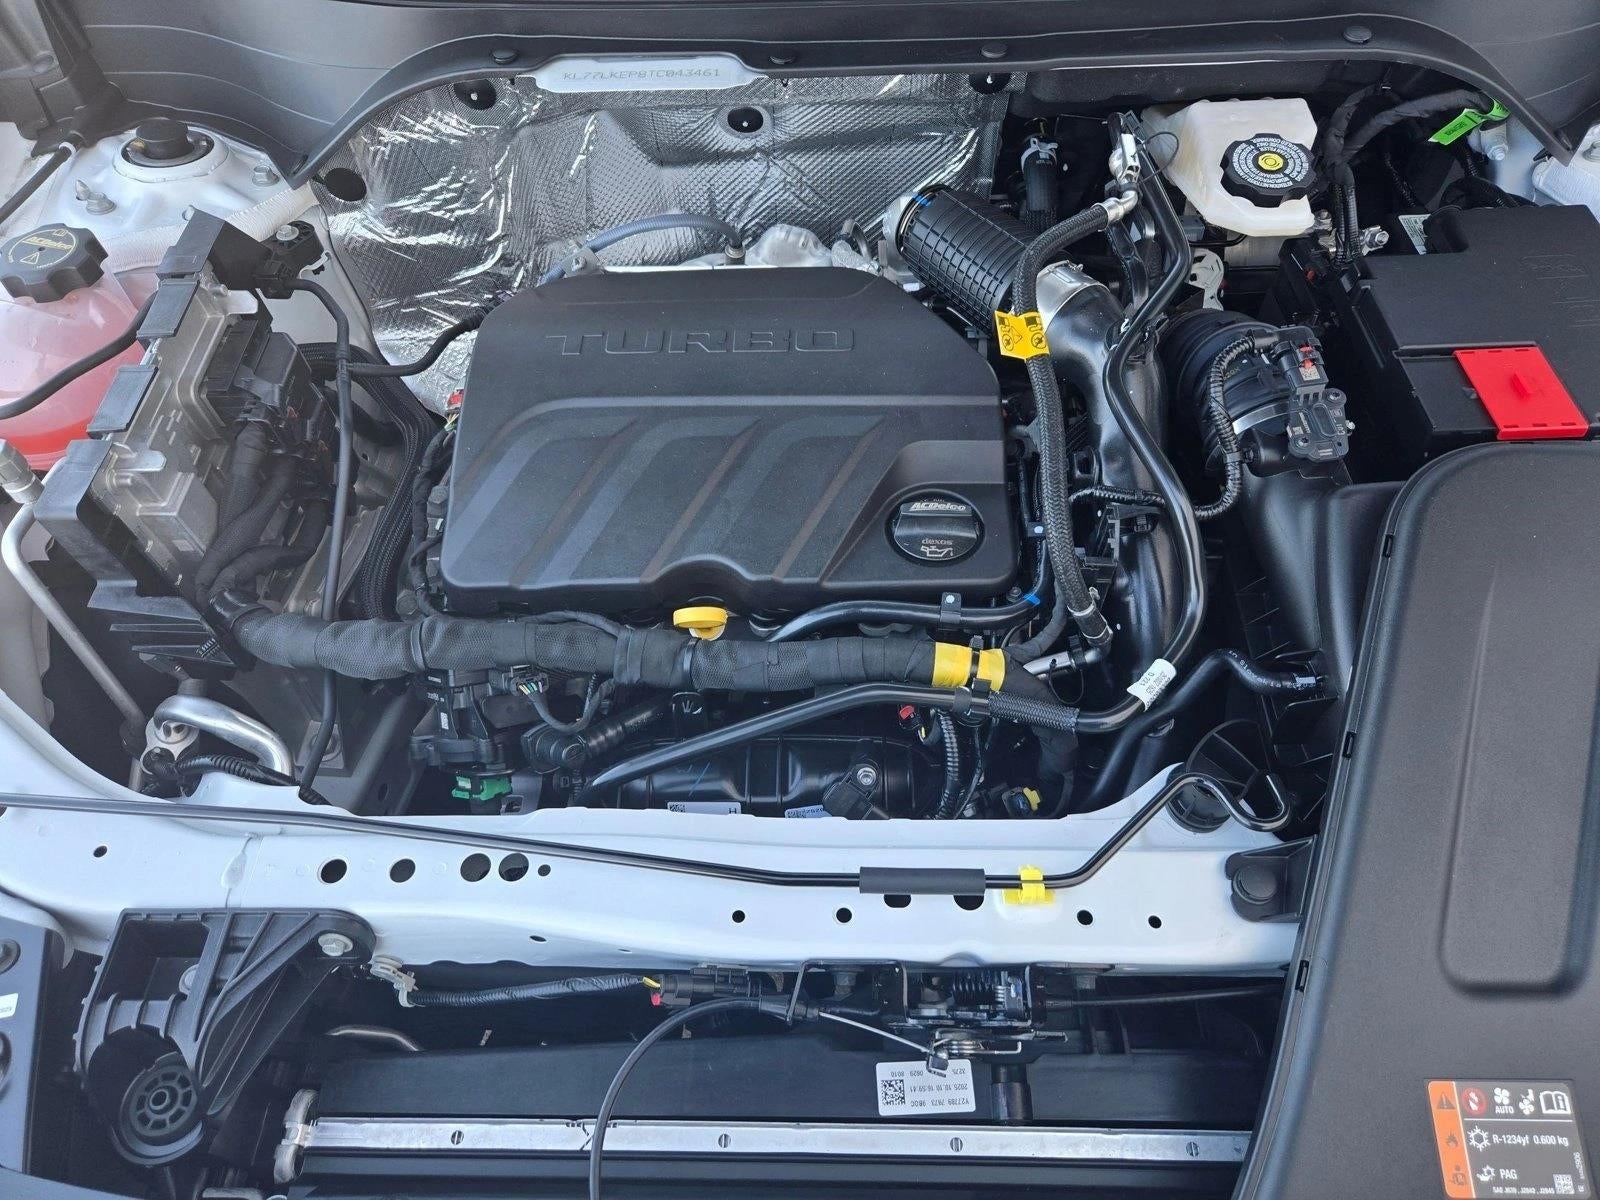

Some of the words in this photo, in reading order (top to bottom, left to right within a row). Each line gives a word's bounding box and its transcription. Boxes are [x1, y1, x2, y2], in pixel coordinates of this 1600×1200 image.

[563, 68, 721, 80] KL77LKEP8TC043461
[546, 329, 857, 356] TURBO
[909, 502, 967, 511] ACDelco
[922, 538, 954, 546] dexos
[1495, 1105, 1515, 1114] AUTO
[1492, 1134, 1530, 1147] R-1234yf
[1533, 1135, 1556, 1145] 0.600
[1558, 1135, 1569, 1147] kg
[1500, 1168, 1518, 1180] PAG
